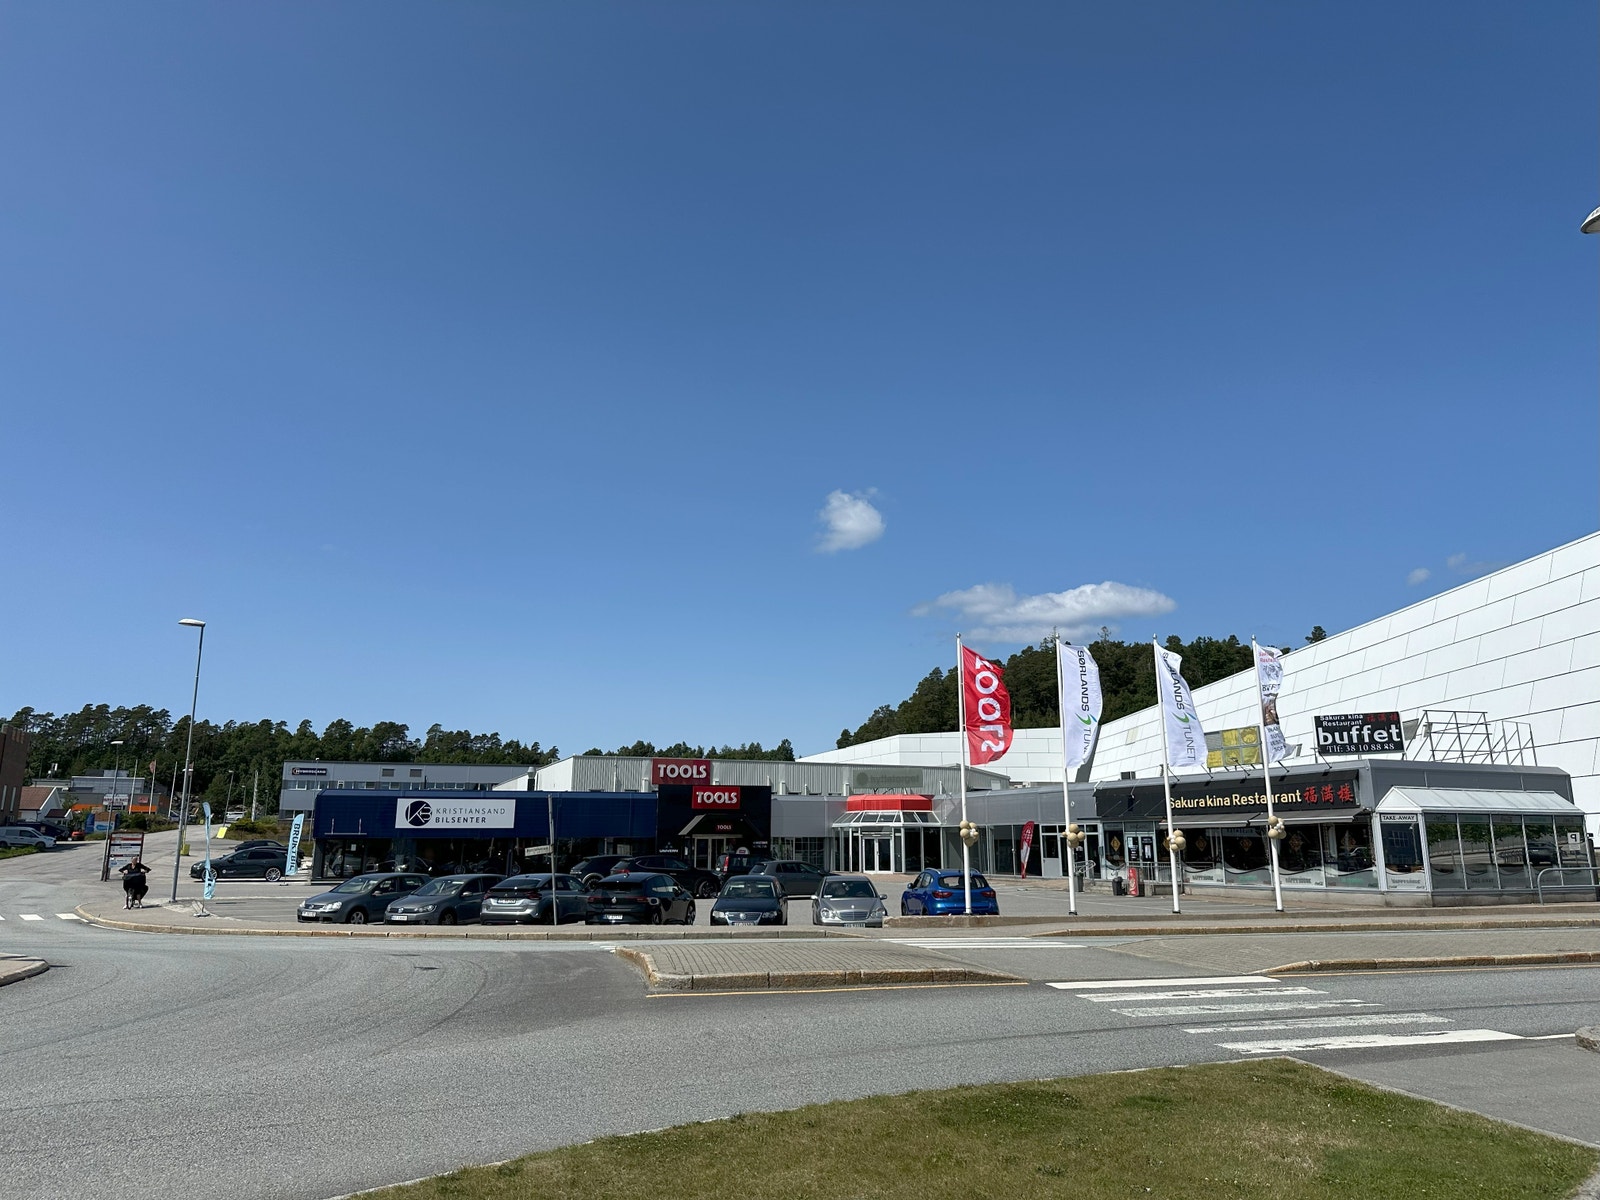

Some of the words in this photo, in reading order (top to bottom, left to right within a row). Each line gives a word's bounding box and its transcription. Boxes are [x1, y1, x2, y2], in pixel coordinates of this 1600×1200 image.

[1077, 650, 1090, 711] SØRLANDS
[1317, 724, 1401, 745] buffet
[1183, 726, 1196, 761] TUNET
[1326, 745, 1343, 753] Tlf:
[658, 764, 707, 778] TOOLS
[696, 792, 738, 804] TOOLS
[1170, 796, 1205, 809] Sakura
[1206, 794, 1229, 807] kina
